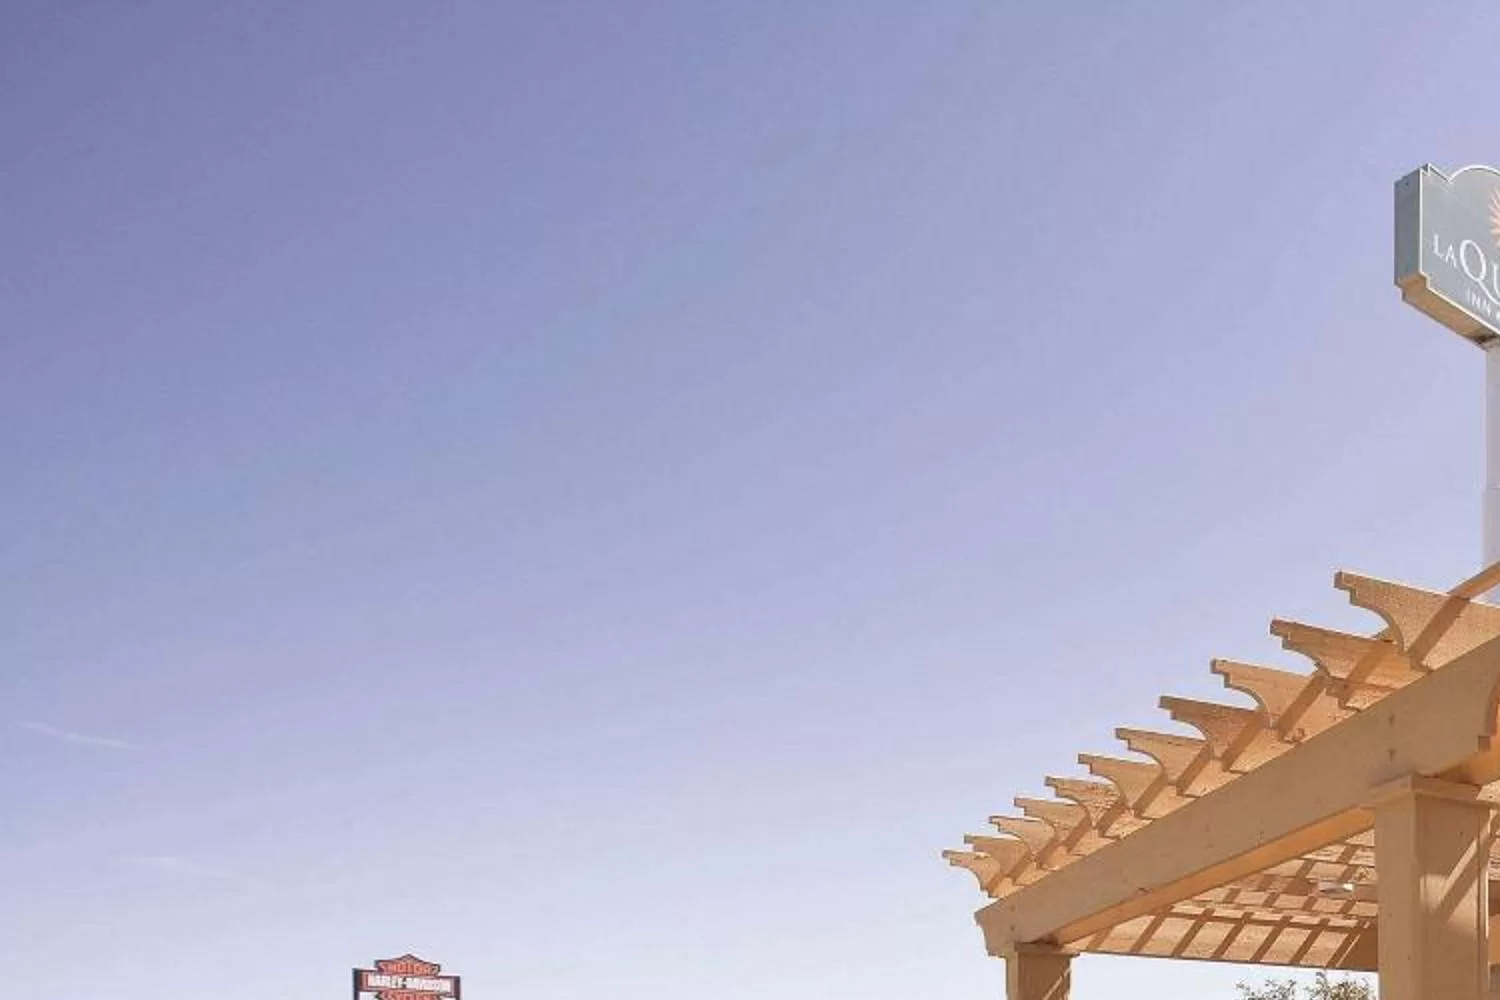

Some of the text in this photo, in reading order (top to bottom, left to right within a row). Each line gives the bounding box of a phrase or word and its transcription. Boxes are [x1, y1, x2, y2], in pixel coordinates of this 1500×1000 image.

[1432, 233, 1458, 268] LA
[1465, 287, 1491, 316] INN
[367, 973, 451, 992] HARLEY-DAVIDSON
